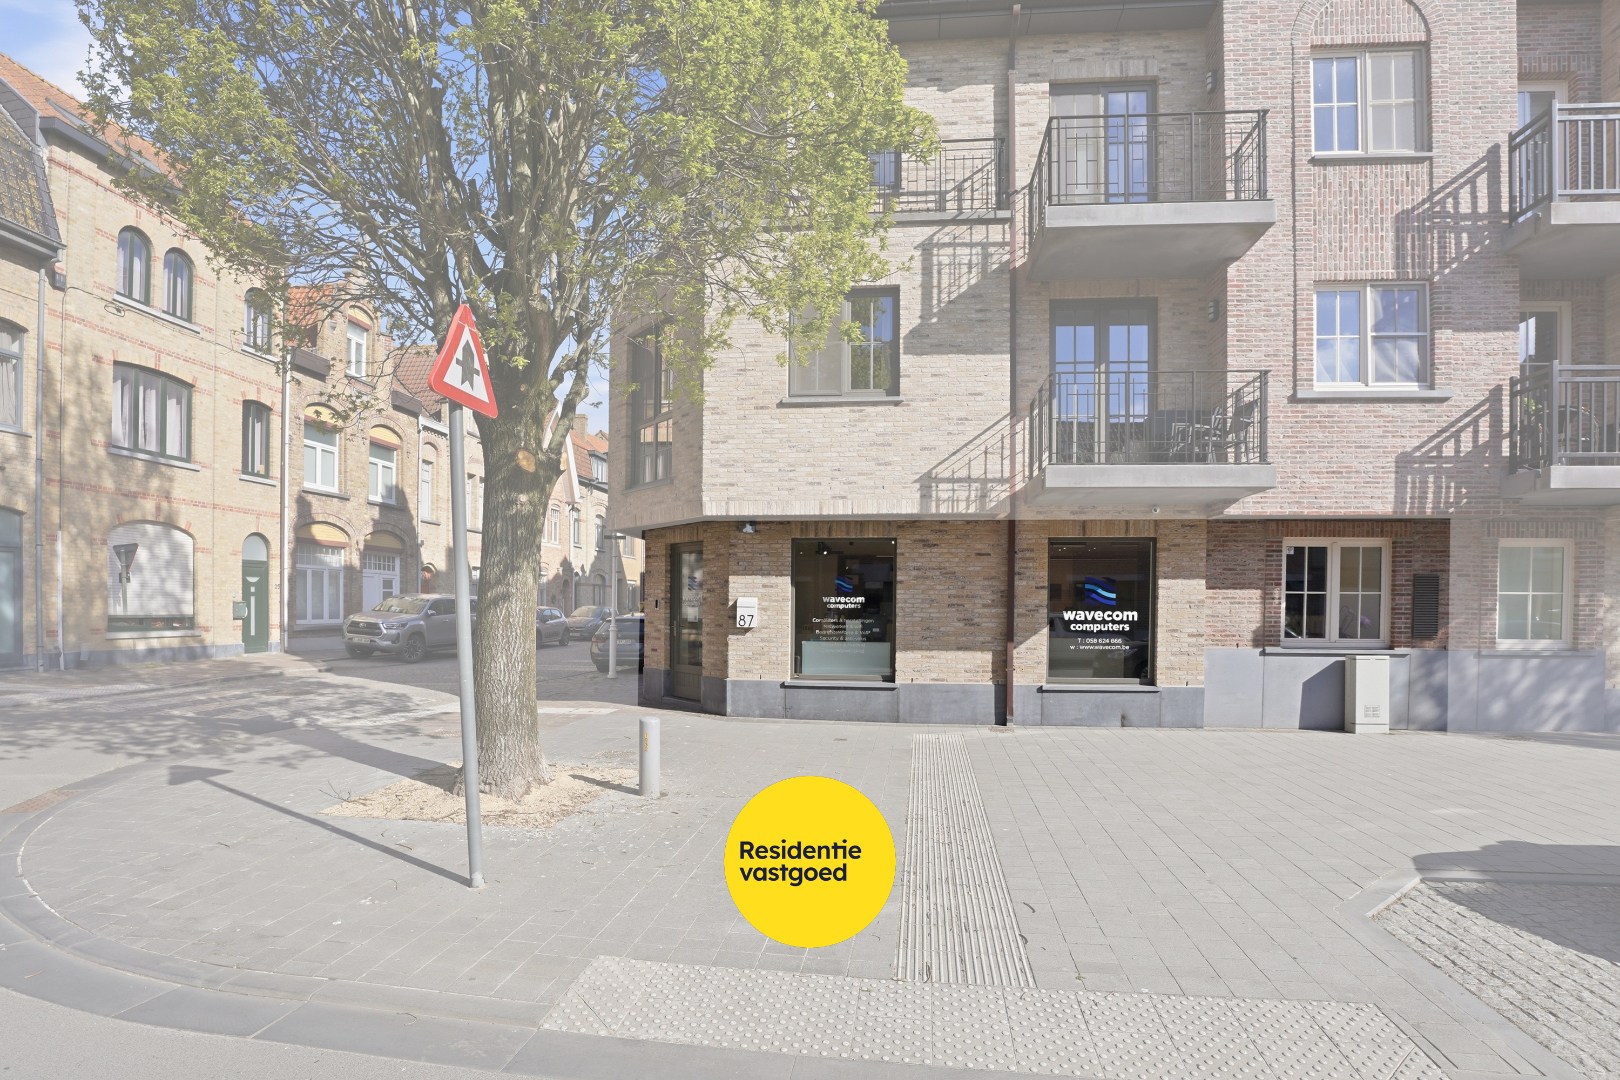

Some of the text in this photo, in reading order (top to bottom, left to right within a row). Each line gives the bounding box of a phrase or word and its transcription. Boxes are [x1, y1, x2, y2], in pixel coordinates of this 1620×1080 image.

[738, 614, 754, 627] 87
[1063, 611, 1138, 621] wavecom
[1070, 623, 1129, 632] computers
